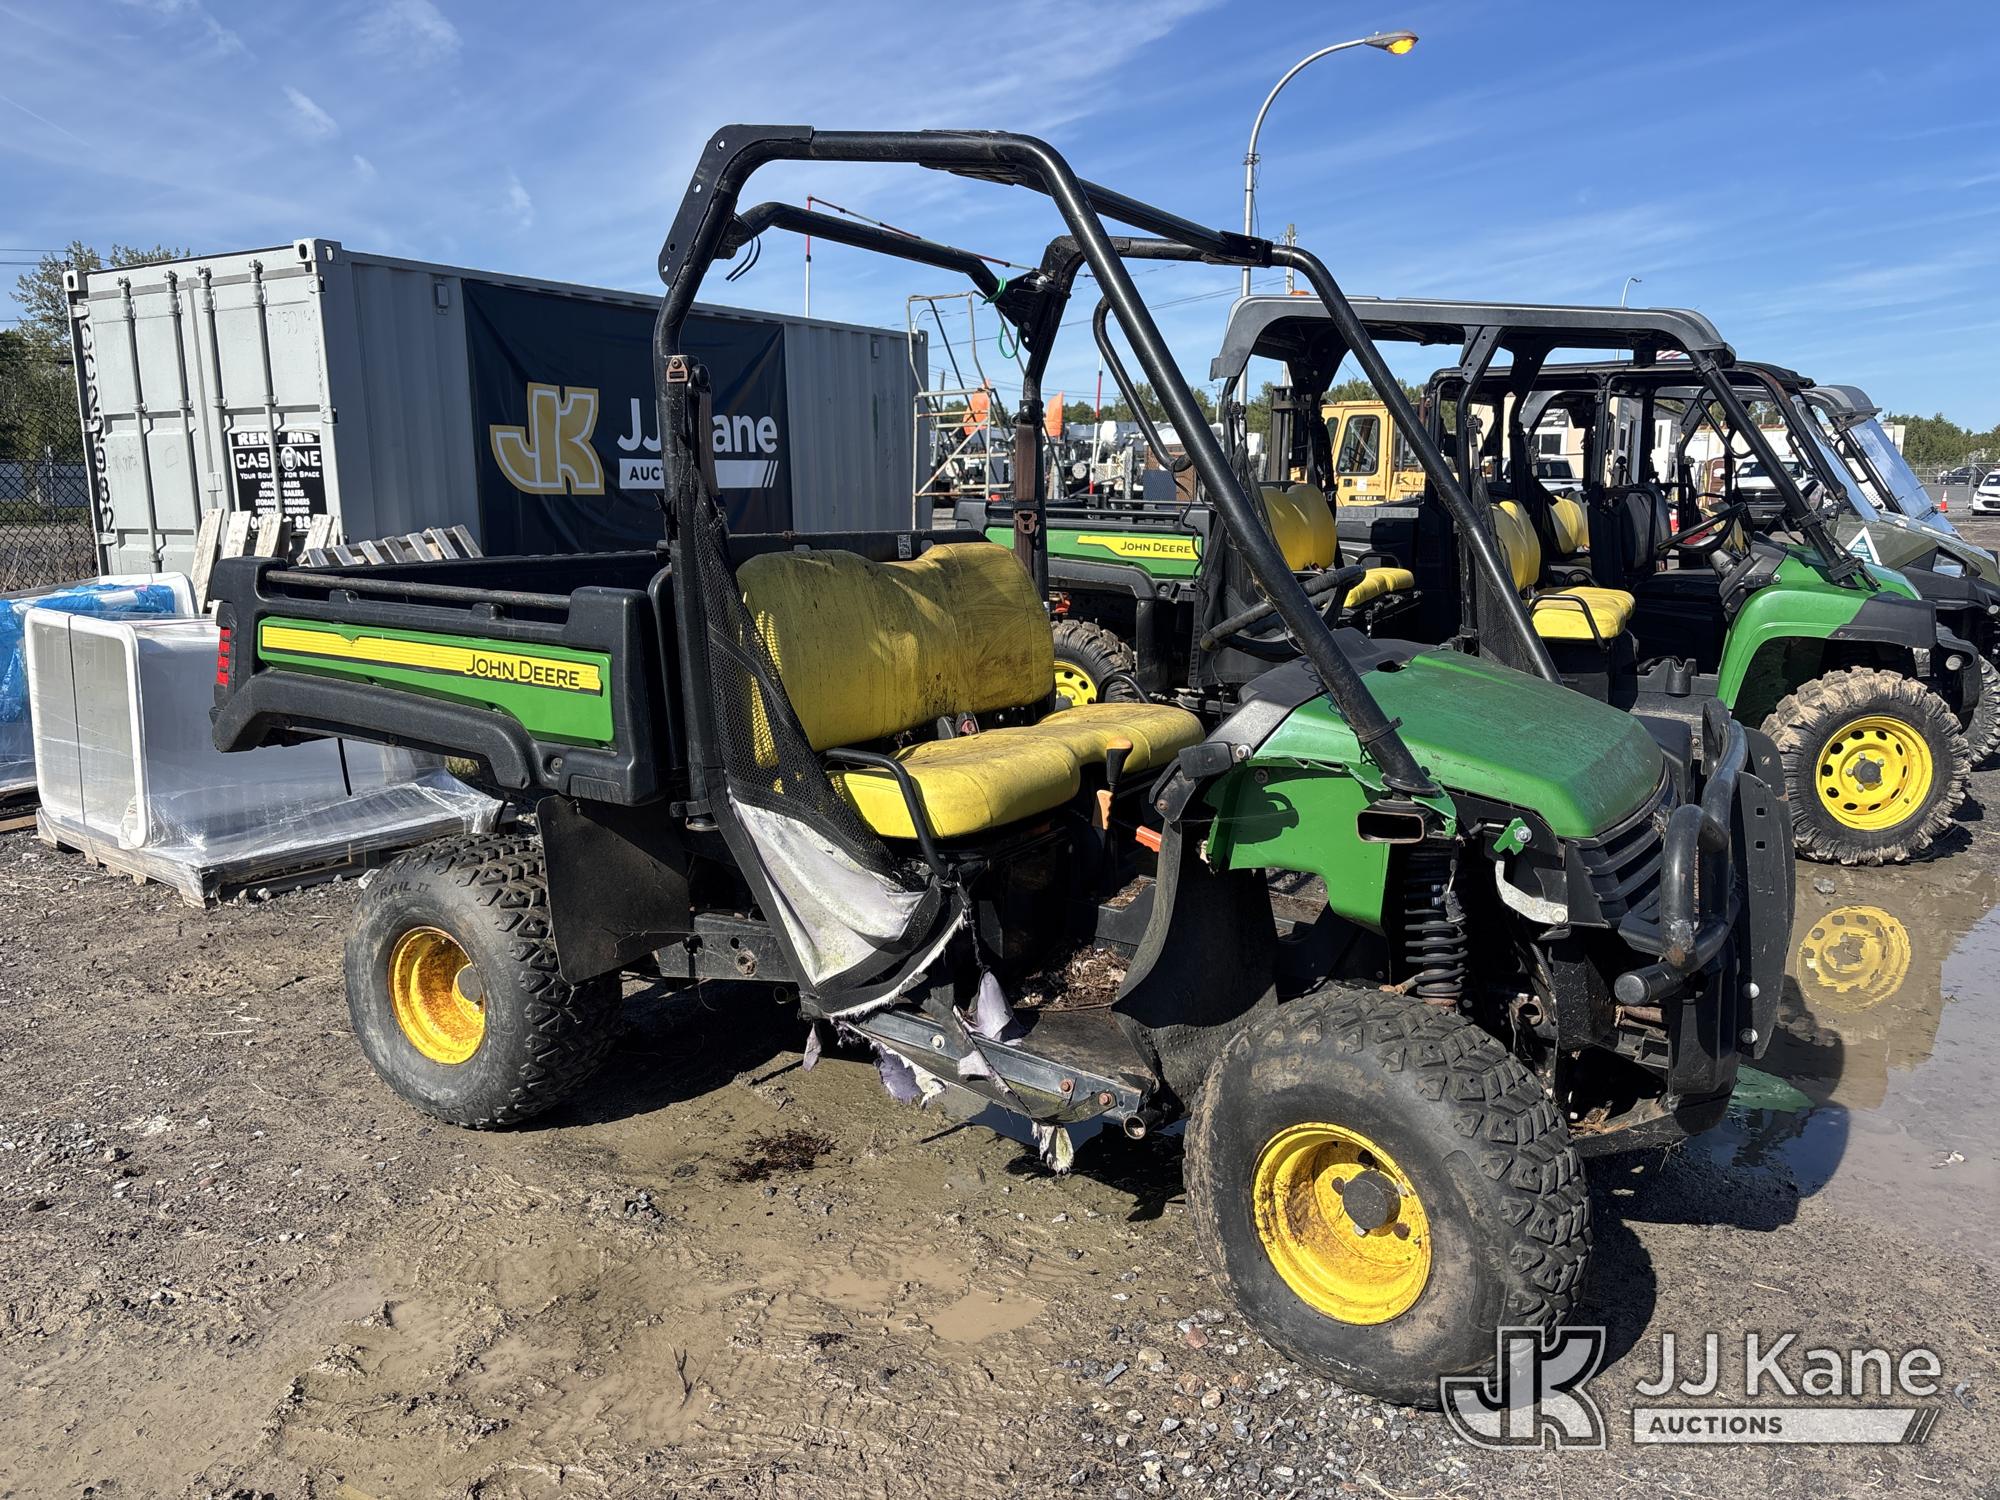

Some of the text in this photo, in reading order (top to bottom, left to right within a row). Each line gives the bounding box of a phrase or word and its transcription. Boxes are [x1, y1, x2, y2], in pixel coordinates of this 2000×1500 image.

[237, 432, 314, 445] REN ME
[712, 414, 778, 454] ane
[235, 446, 321, 469] CASONE
[1120, 541, 1191, 554] JOHN DEERE
[466, 653, 580, 687] JOHN DEERE
